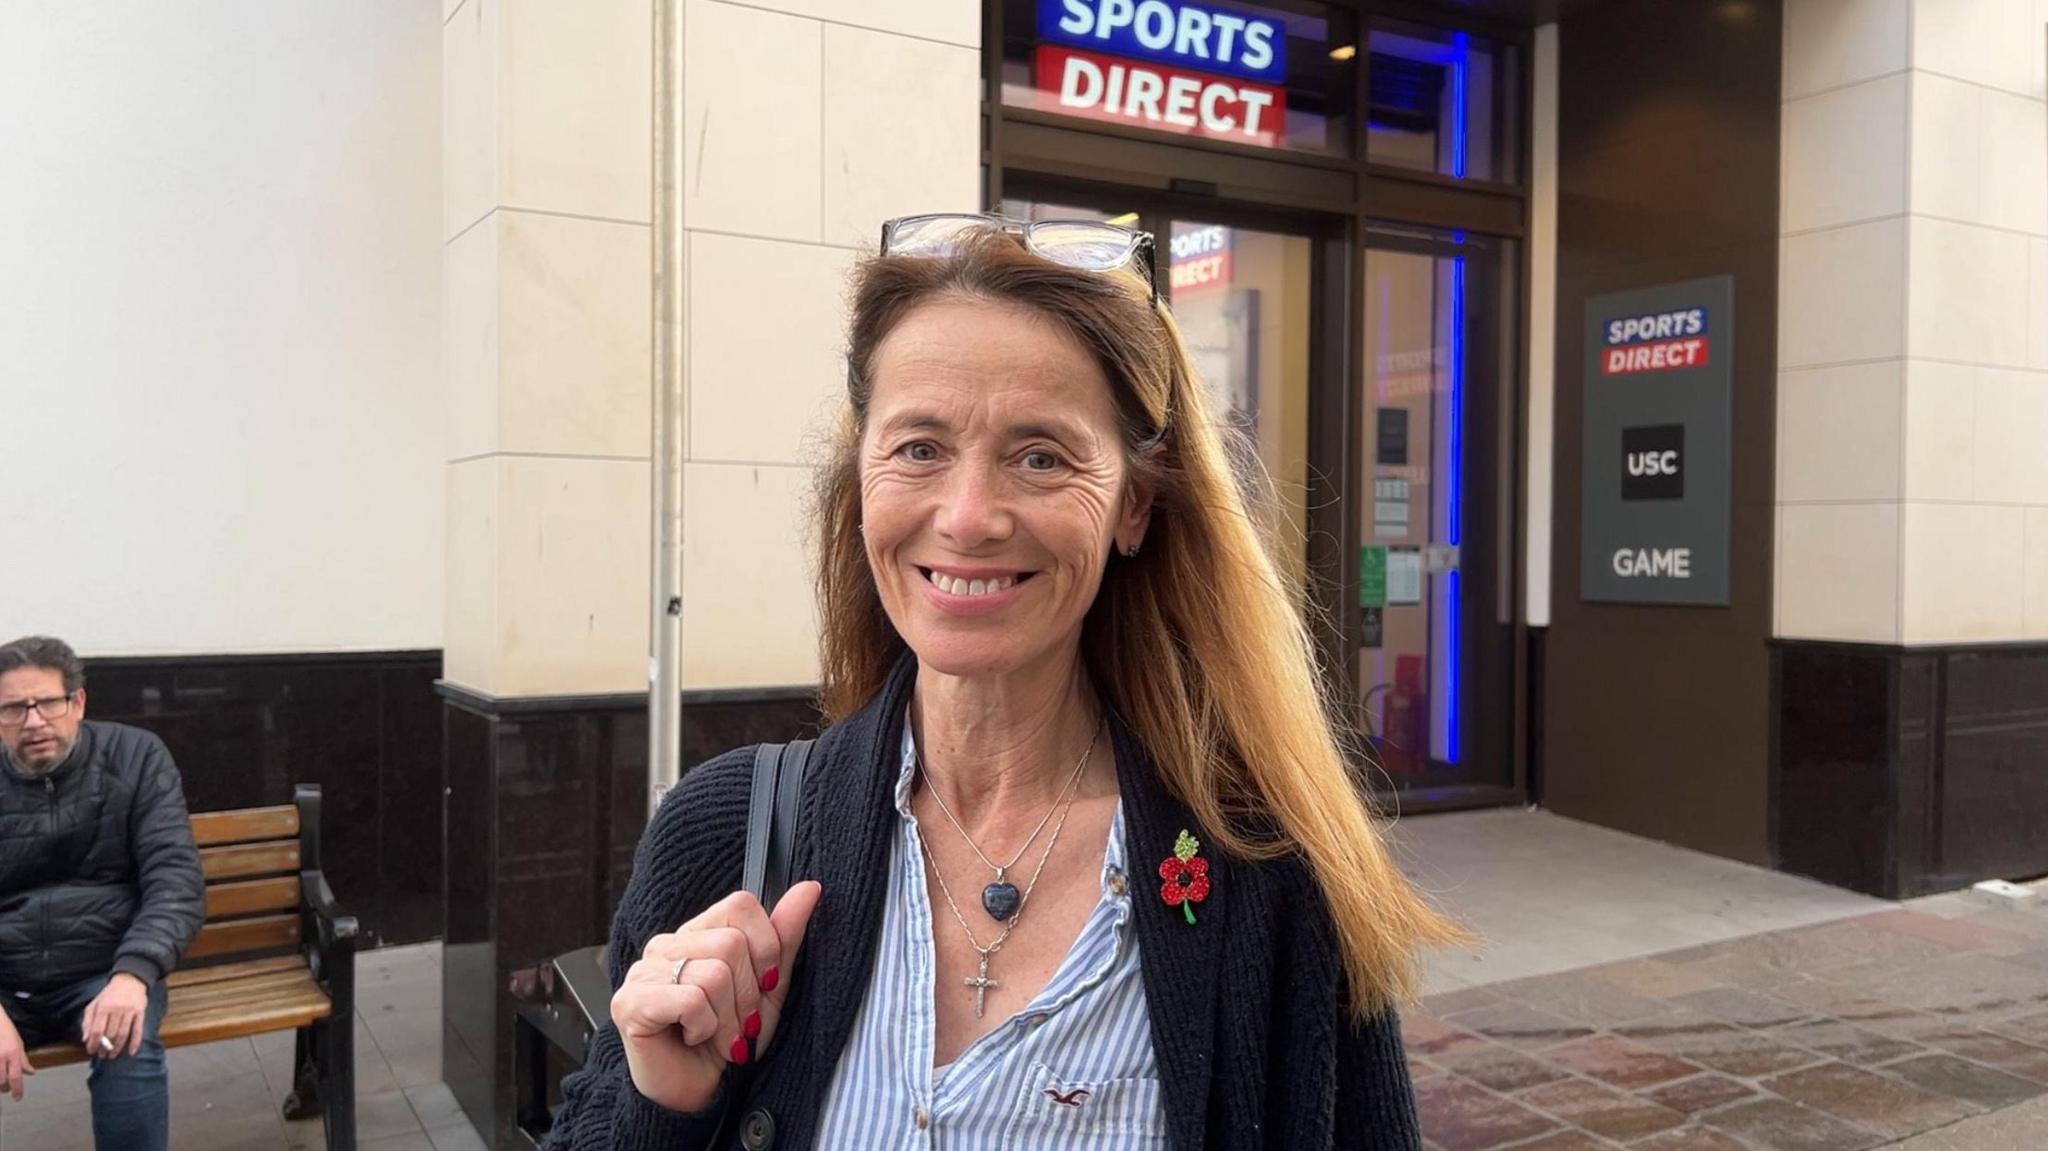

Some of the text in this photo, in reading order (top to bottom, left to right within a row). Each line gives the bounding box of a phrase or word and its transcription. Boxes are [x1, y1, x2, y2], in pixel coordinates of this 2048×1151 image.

[1058, 0, 1275, 69] SPORTS
[1060, 57, 1274, 136] DIRECT
[1608, 309, 1703, 344] SPORTS
[1608, 340, 1702, 373] DIRECT
[1628, 450, 1679, 476] USC
[1613, 547, 1691, 578] GAME
